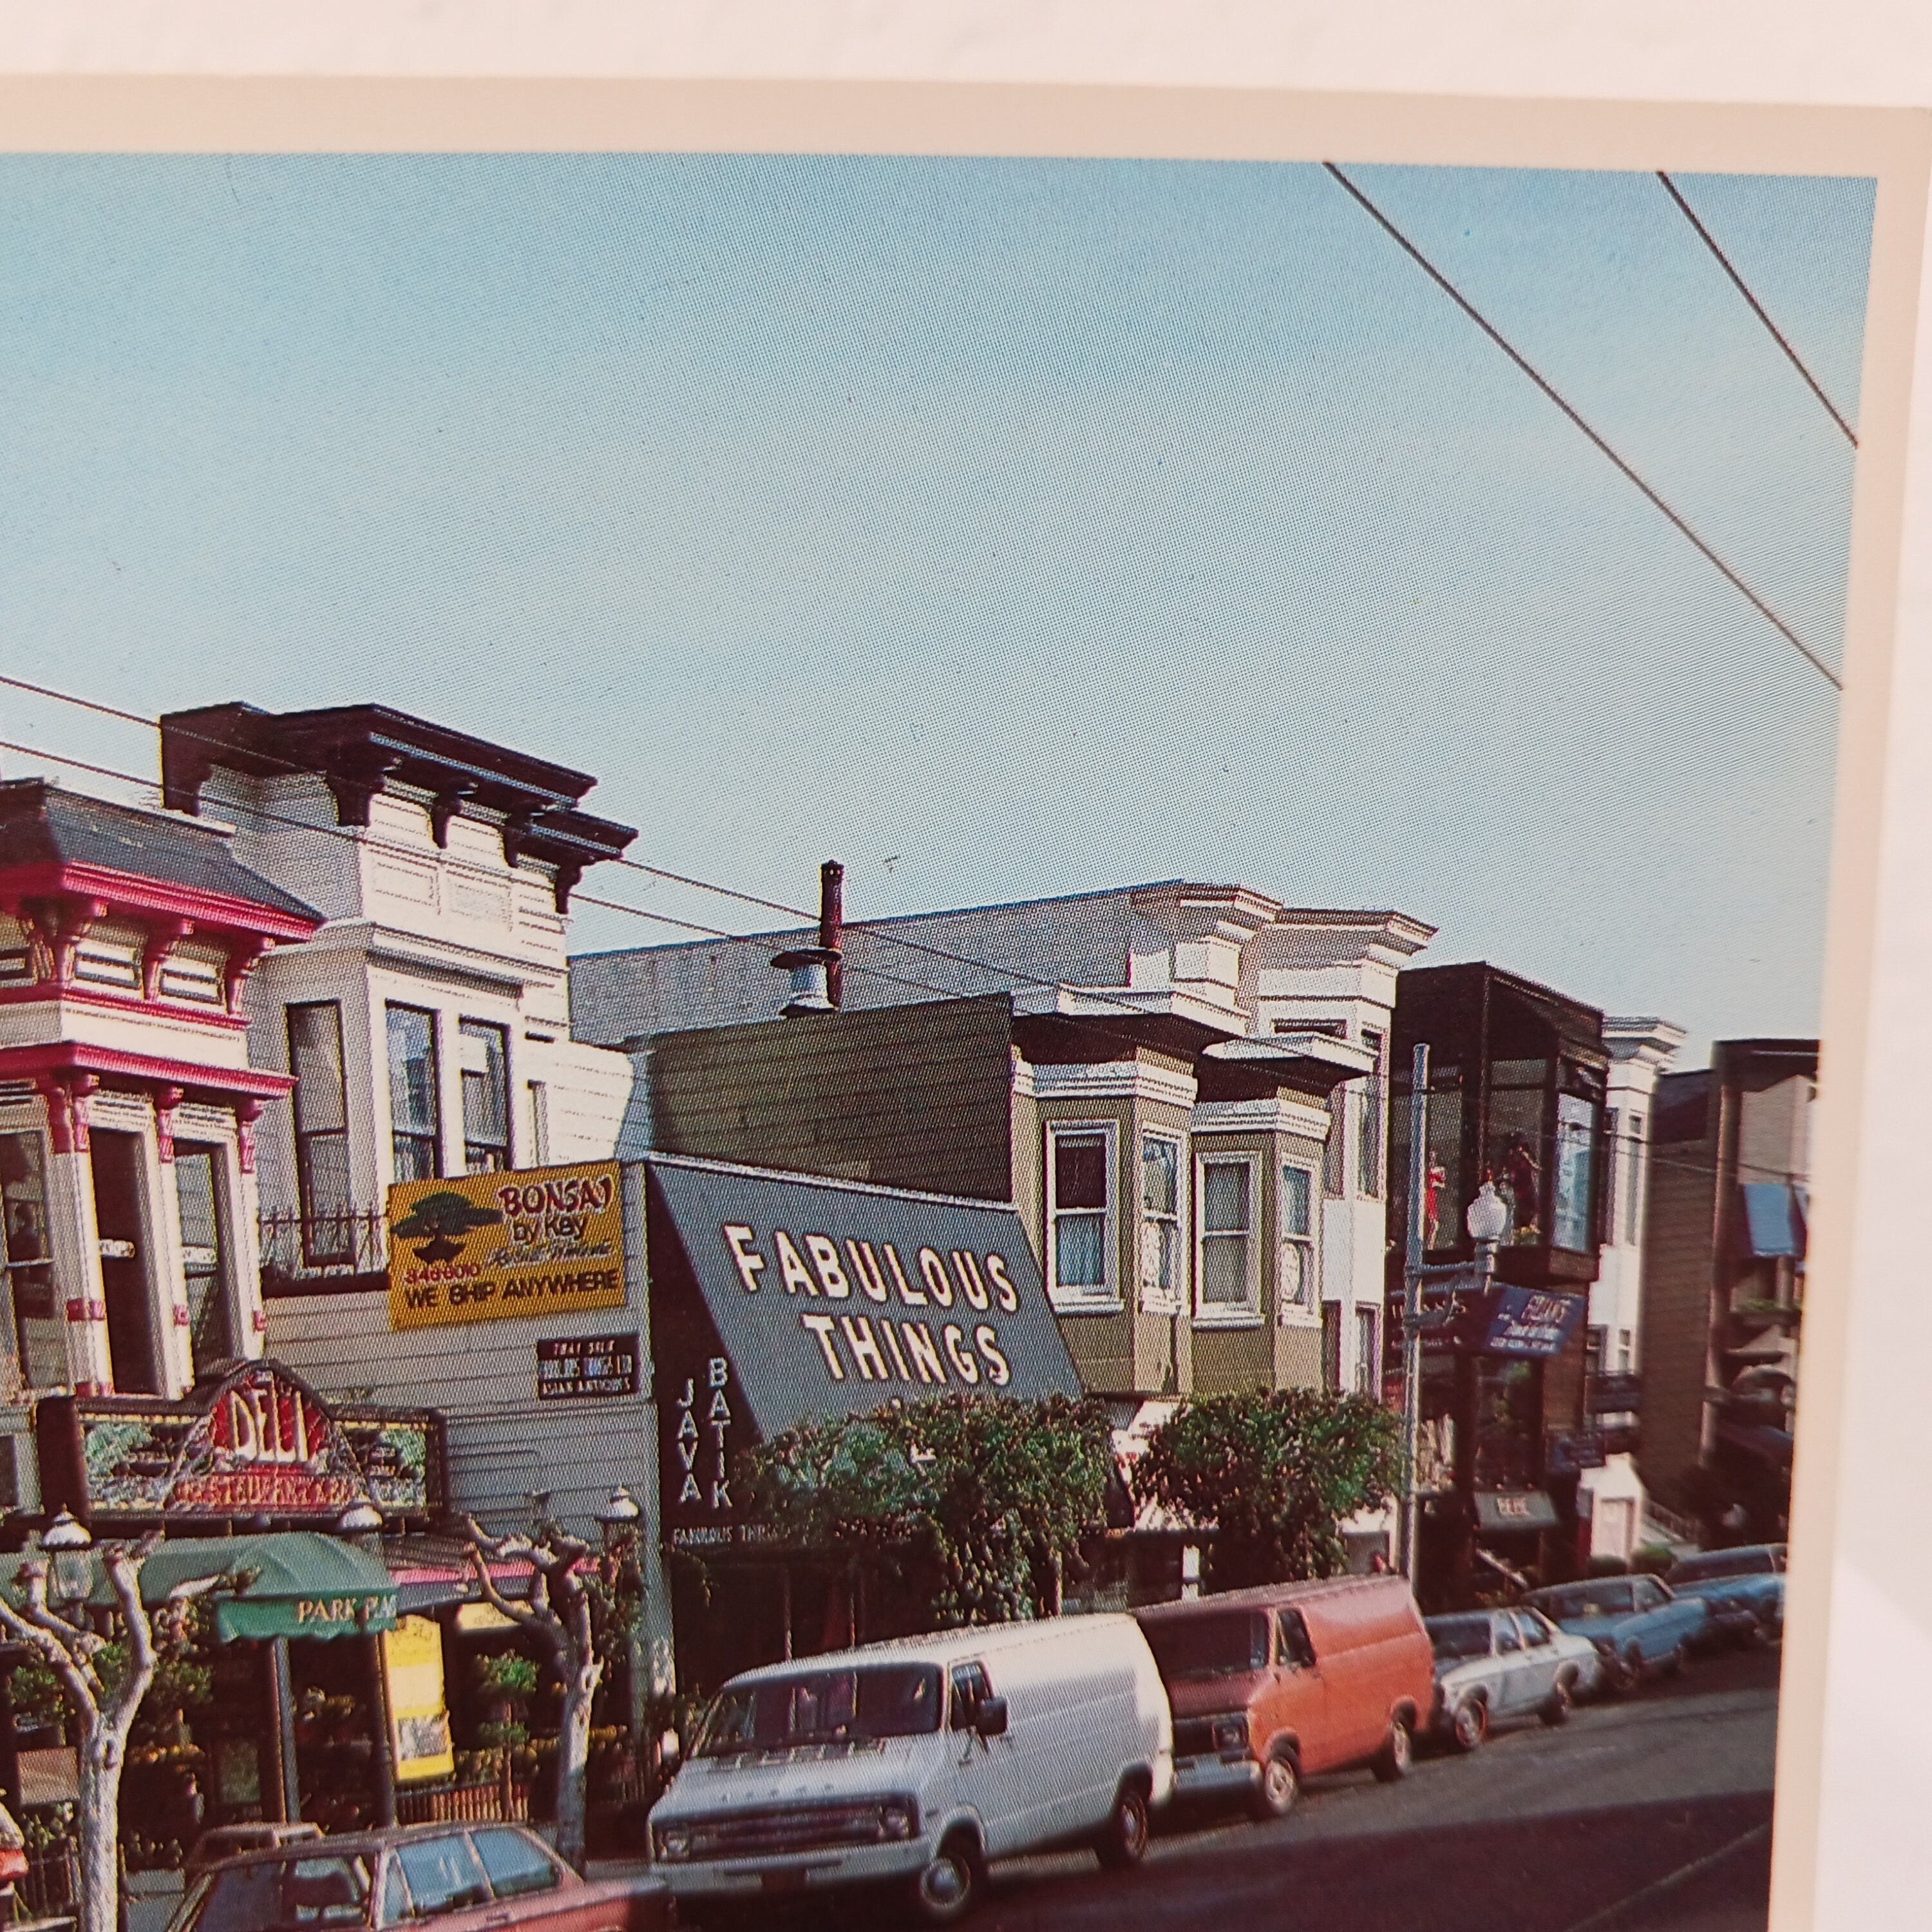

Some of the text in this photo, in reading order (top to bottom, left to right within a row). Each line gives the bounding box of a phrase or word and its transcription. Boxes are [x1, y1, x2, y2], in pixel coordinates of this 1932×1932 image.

[497, 1175, 615, 1217] BONSAI
[404, 1269, 621, 1309] WE SHIP ANYWHERE
[724, 1224, 1018, 1312] FABULOUS
[800, 1314, 1010, 1386] THINGS
[227, 1386, 308, 1463] DELI
[676, 1378, 702, 1503] JAVA
[708, 1357, 732, 1509] BATIK
[298, 1597, 356, 1624] PARK
